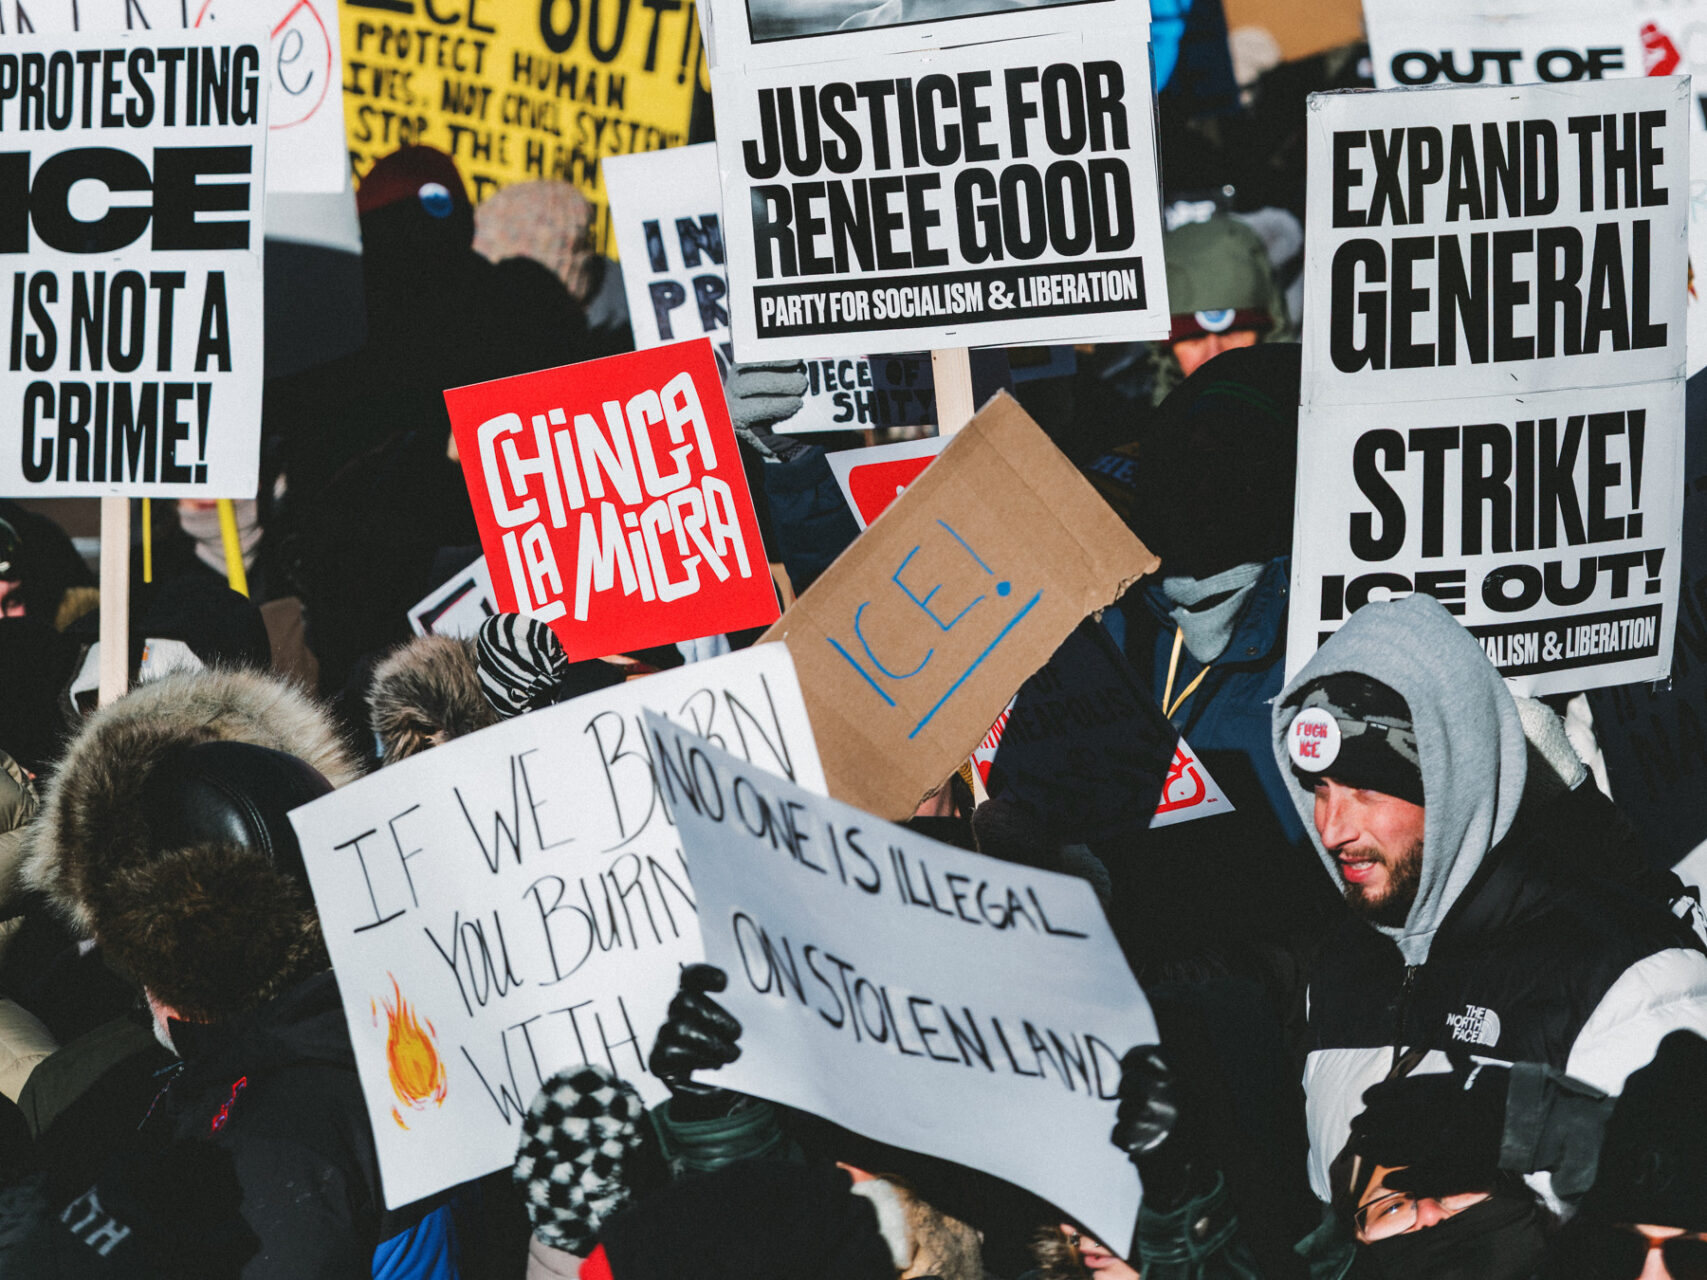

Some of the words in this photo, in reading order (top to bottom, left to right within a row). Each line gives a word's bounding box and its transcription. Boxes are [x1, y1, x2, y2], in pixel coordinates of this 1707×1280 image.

[0, 44, 259, 131] PROTESTING
[356, 21, 487, 74] PROTECT
[512, 51, 627, 112] HUMAN
[441, 77, 493, 121] NOT
[1391, 50, 1522, 85] OUT
[1536, 47, 1625, 83] OF
[447, 124, 508, 166] THE
[742, 71, 1000, 180] JUSTICE
[1003, 60, 1131, 158] FOR
[1332, 117, 1559, 228] EXPAND
[1568, 109, 1669, 213] THE
[0, 145, 253, 254] ICE
[750, 172, 949, 279] RENEE
[954, 157, 1135, 264] GOOD
[9, 270, 58, 372] IS
[69, 270, 186, 373] NOT
[194, 271, 232, 372] A
[760, 291, 829, 328] PARTY
[829, 286, 870, 322] FOR
[872, 281, 984, 319] SOCIALISM
[988, 280, 1015, 311] &
[1017, 269, 1138, 308] LIBERATION
[1330, 219, 1668, 374] GENERAL
[21, 380, 212, 484] CRIME!
[1350, 409, 1647, 562] STRIKE!
[502, 522, 567, 624] LA
[826, 518, 1012, 707] ICE!
[1320, 569, 1467, 621] ICE
[1481, 547, 1666, 613] OUT!
[1541, 630, 1564, 662] &
[1565, 615, 1657, 659] LIBERATION
[333, 802, 424, 934] IF
[453, 748, 576, 874] WE
[654, 729, 724, 823] NO
[734, 776, 827, 874] ONE
[827, 821, 881, 895] IS
[889, 845, 1091, 940] ILLEGAL
[424, 910, 525, 1019] YOU
[521, 848, 698, 988] BURN
[733, 911, 808, 1006] ON
[805, 943, 995, 1072] STOLEN
[991, 1016, 1124, 1101] LAND
[1446, 1012, 1483, 1032] NORTH
[1452, 1027, 1479, 1043] FACE
[1465, 1004, 1486, 1020] THE
[460, 995, 648, 1126] WITH
